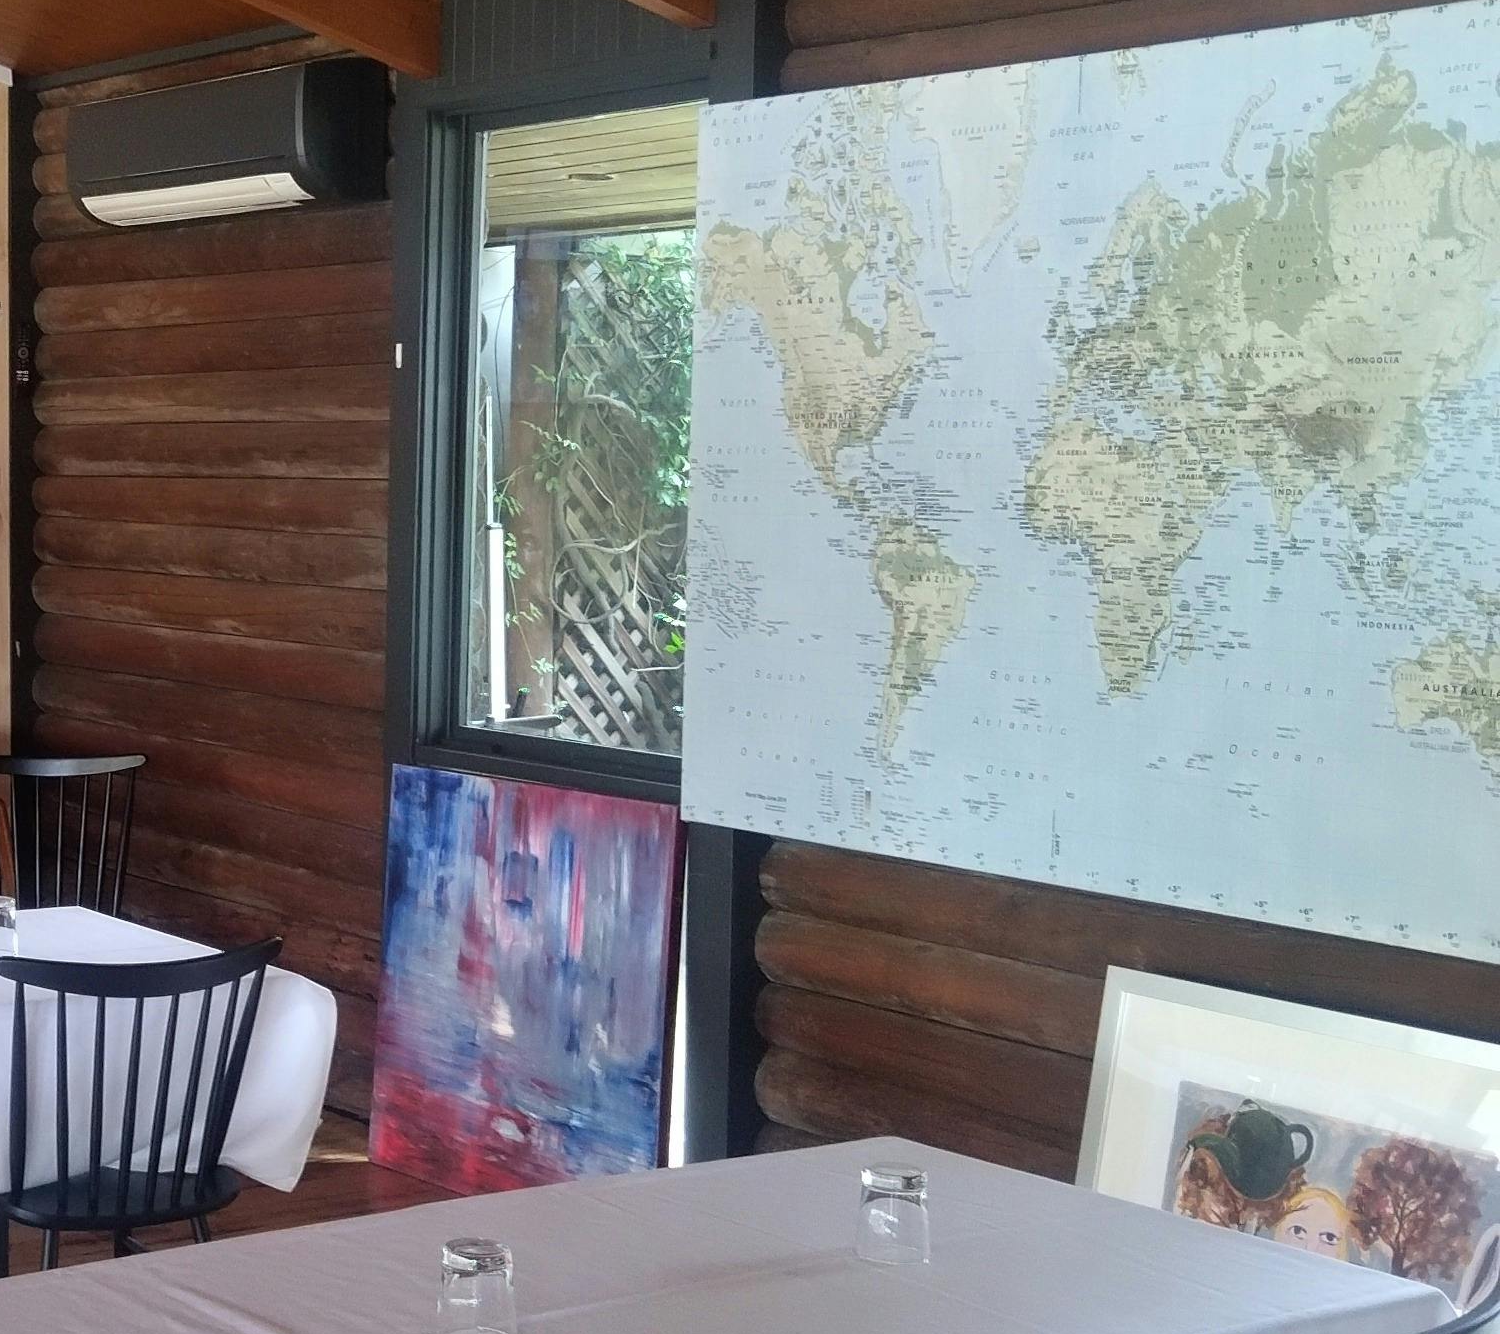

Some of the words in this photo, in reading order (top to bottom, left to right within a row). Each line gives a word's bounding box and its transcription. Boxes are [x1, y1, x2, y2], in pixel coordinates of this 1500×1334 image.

[1049, 122, 1120, 138] GREENLAND
[1073, 151, 1094, 162] SEA
[1246, 249, 1455, 272] RUSSIAN
[1260, 269, 1437, 285] FEDERATION
[776, 295, 834, 306] CANADA
[1221, 351, 1304, 360] KAZAKHSTAN
[1346, 356, 1400, 365] MONGOLIA
[939, 388, 984, 398] North
[719, 397, 758, 409] North
[1316, 406, 1376, 415] CHINA
[927, 419, 993, 430] Atlantic
[935, 449, 983, 460] Ocean
[1274, 488, 1304, 496] INDIA
[909, 574, 954, 584] BRAZIL
[1357, 620, 1416, 632] INDONESIA
[754, 669, 806, 682] South
[990, 670, 1052, 684] South
[1225, 678, 1334, 697] Indian
[972, 715, 1068, 737] Atlantic
[740, 747, 817, 766] Ocean
[1229, 743, 1324, 764] Ocean
[986, 764, 1049, 782] Ocean
